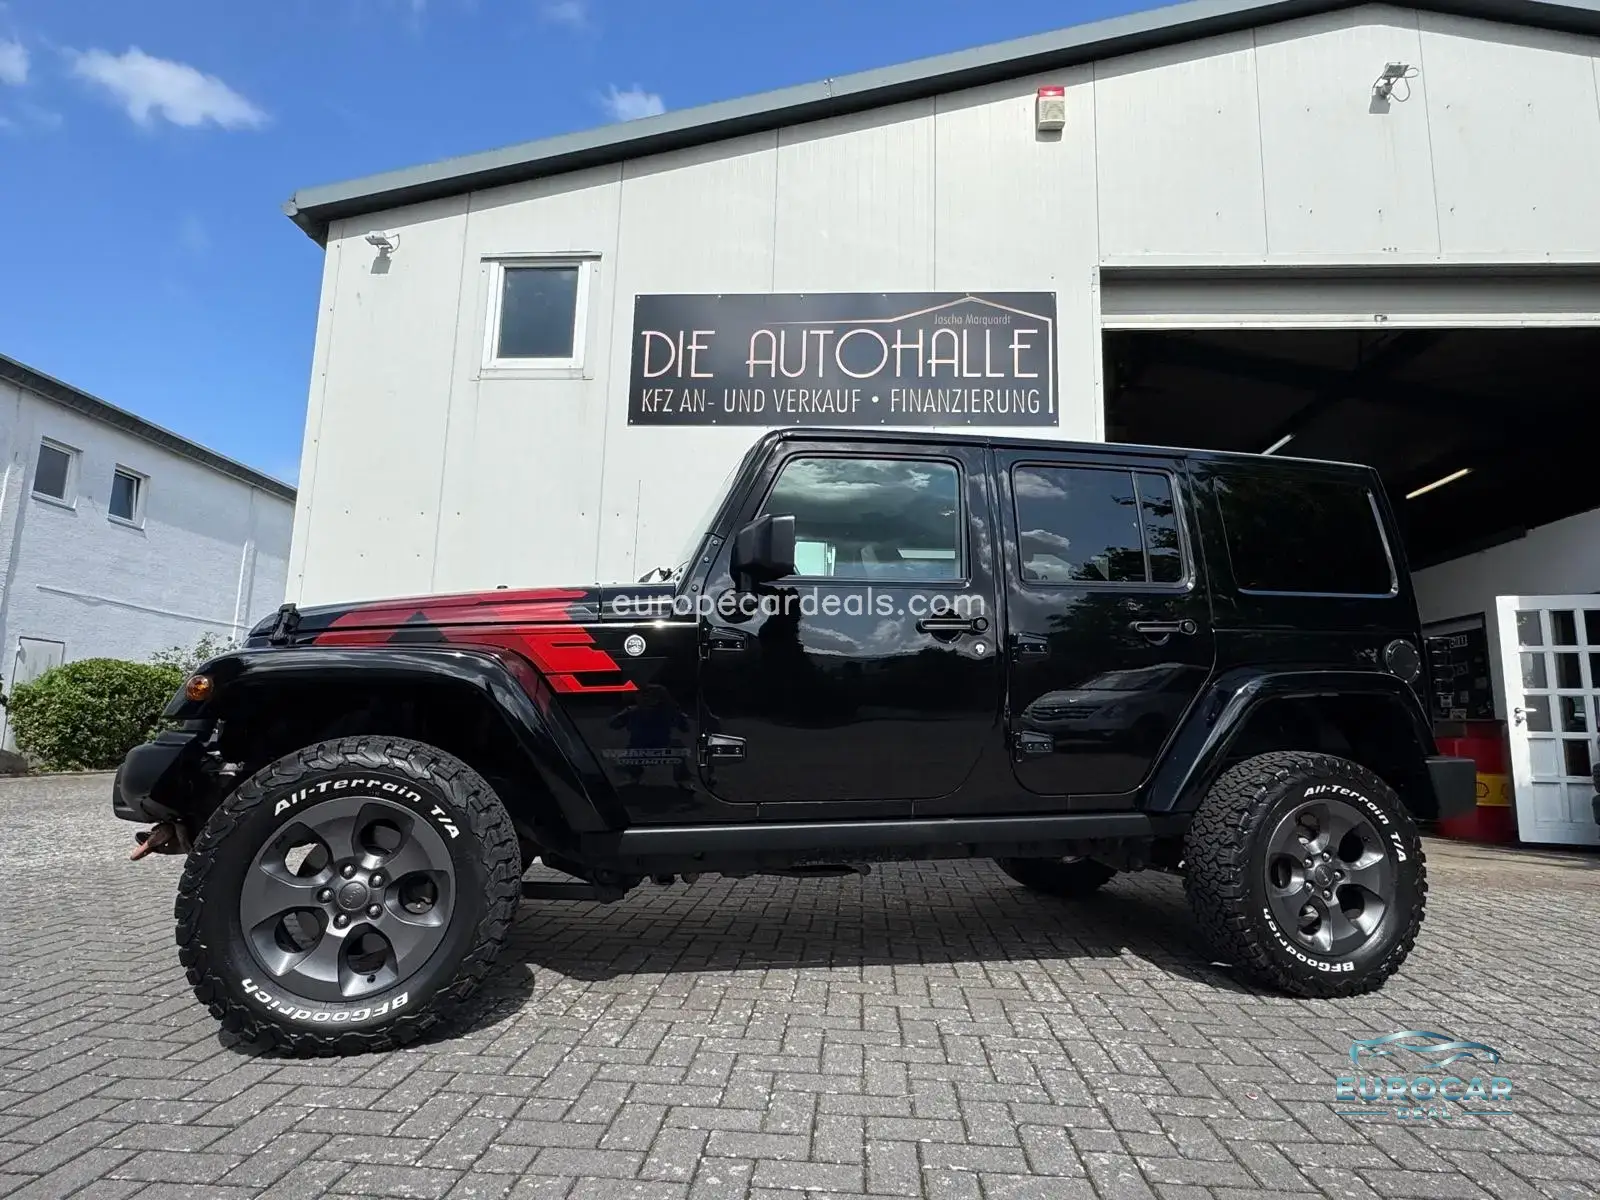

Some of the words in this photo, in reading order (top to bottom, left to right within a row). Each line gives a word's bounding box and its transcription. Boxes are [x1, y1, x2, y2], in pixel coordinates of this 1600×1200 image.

[934, 313, 963, 326] Jascha
[965, 313, 1012, 327] Marquardt
[641, 329, 716, 378] DIE
[745, 328, 1039, 378] AUTOHALLE
[641, 388, 674, 413] KFZ
[679, 388, 715, 413] AN-
[724, 388, 766, 413] UND
[773, 388, 861, 413] VERKAUF
[890, 388, 1040, 414] FINANZIERUNG
[274, 778, 422, 816] All-Terrain
[430, 804, 460, 840] T/A
[1304, 785, 1390, 825] All-Terrain
[1390, 831, 1407, 862] T/A
[241, 978, 409, 1022] BFGoodrich
